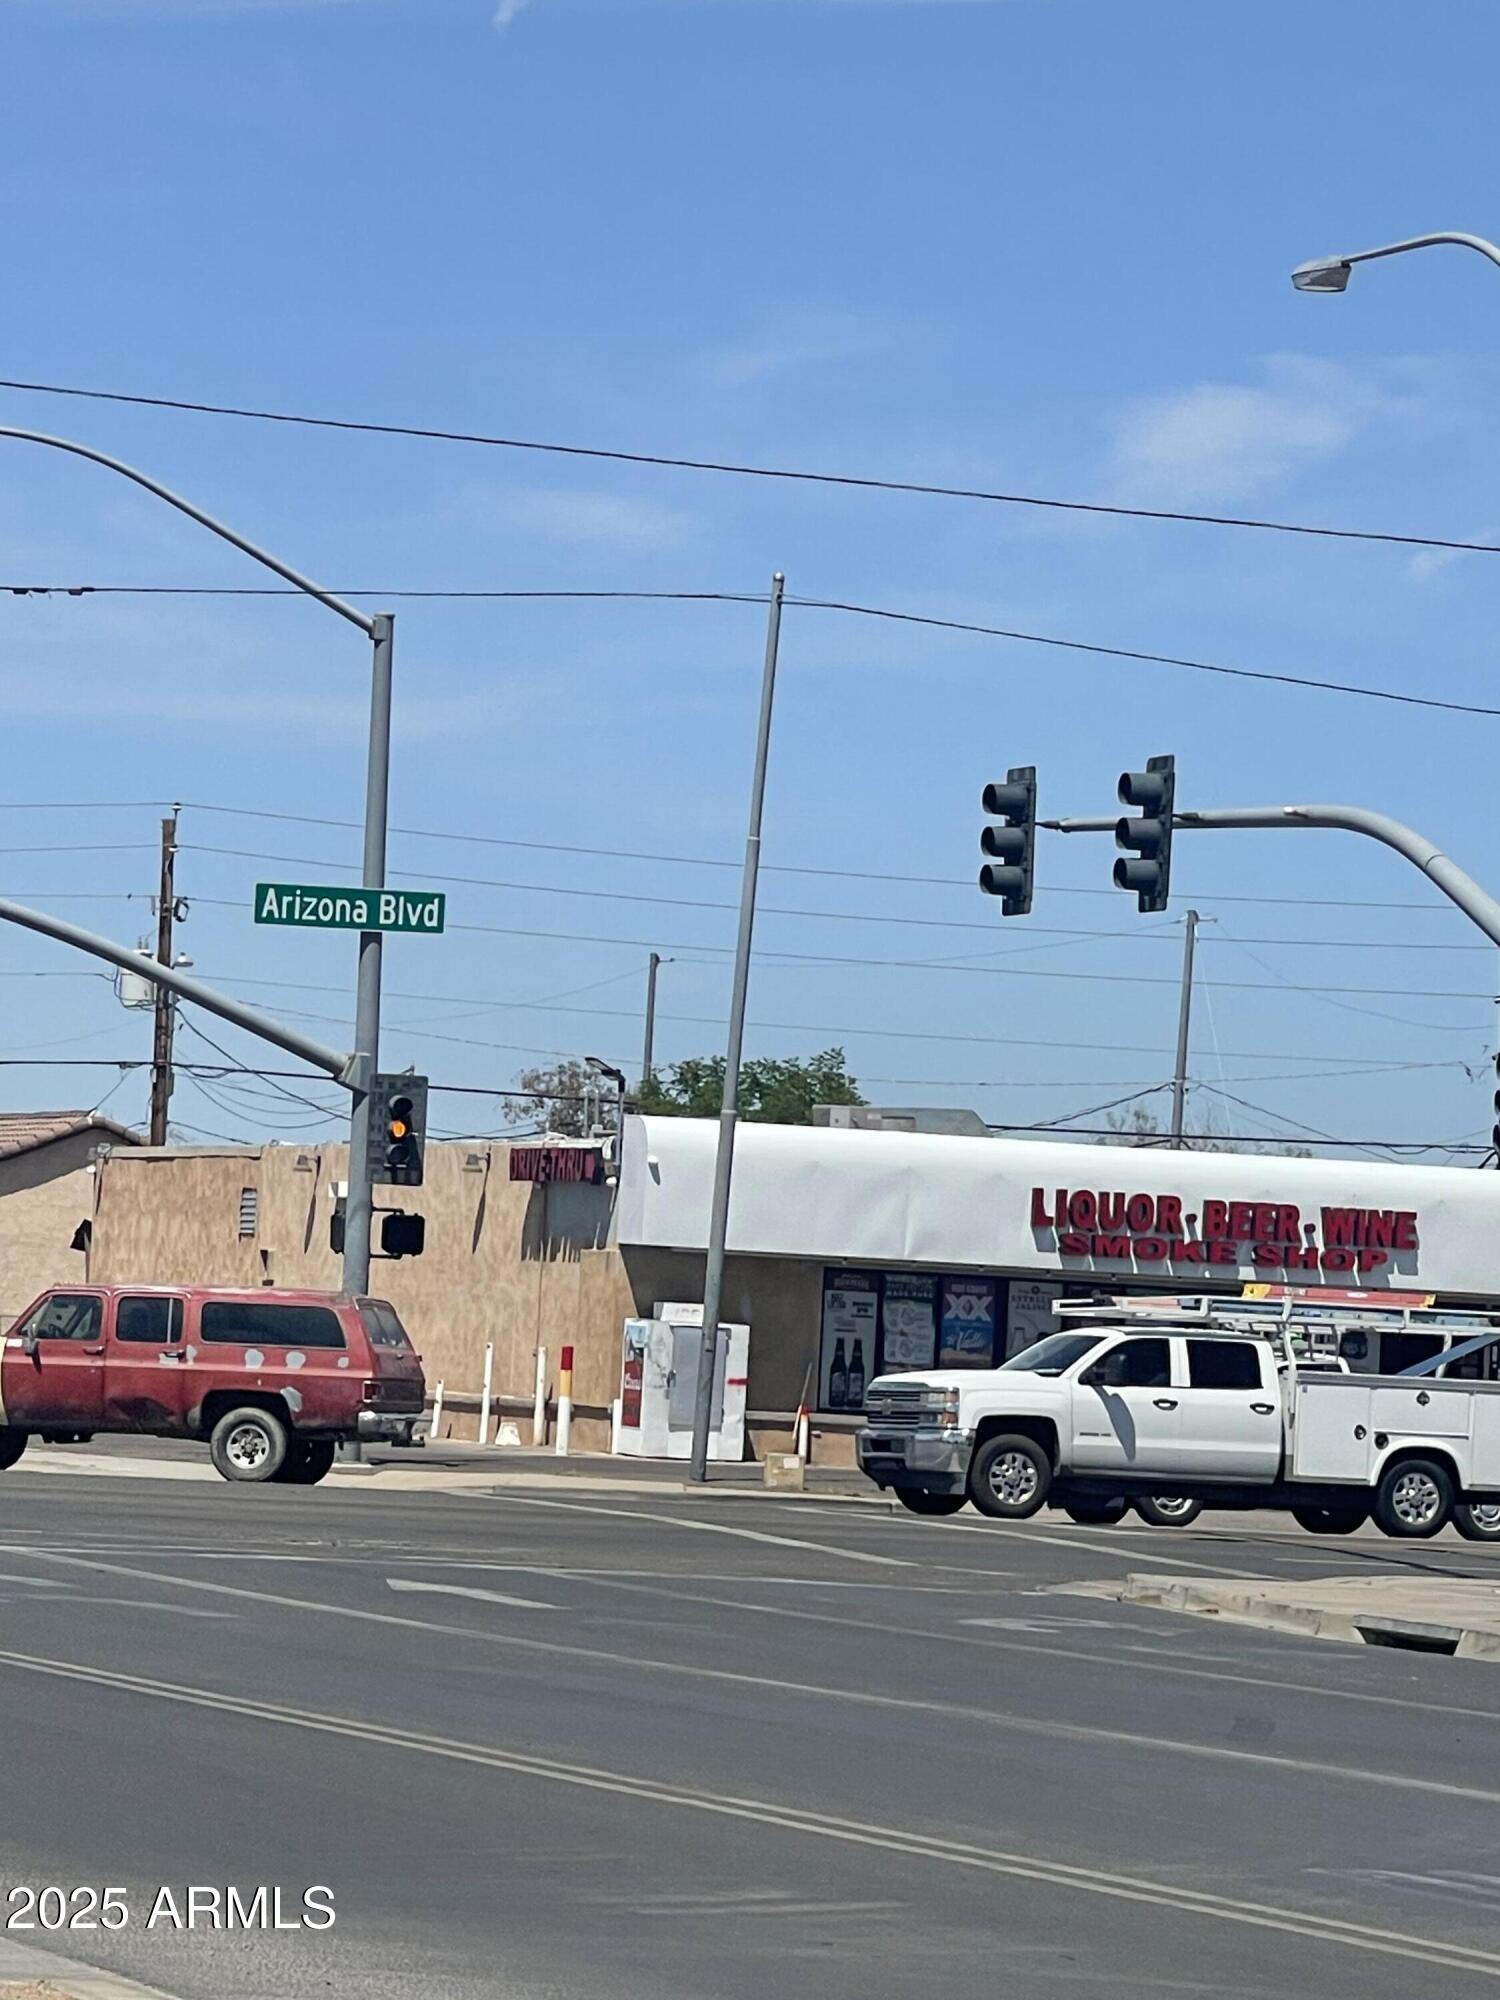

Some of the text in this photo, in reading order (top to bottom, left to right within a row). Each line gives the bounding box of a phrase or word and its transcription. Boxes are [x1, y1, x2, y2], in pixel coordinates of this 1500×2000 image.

[261, 887, 440, 927] Arizona Blvd
[1031, 1187, 1420, 1250] LIQUOR BEER WINE
[1057, 1232, 1388, 1273] SMOKE SHOP
[943, 1293, 993, 1321] XX
